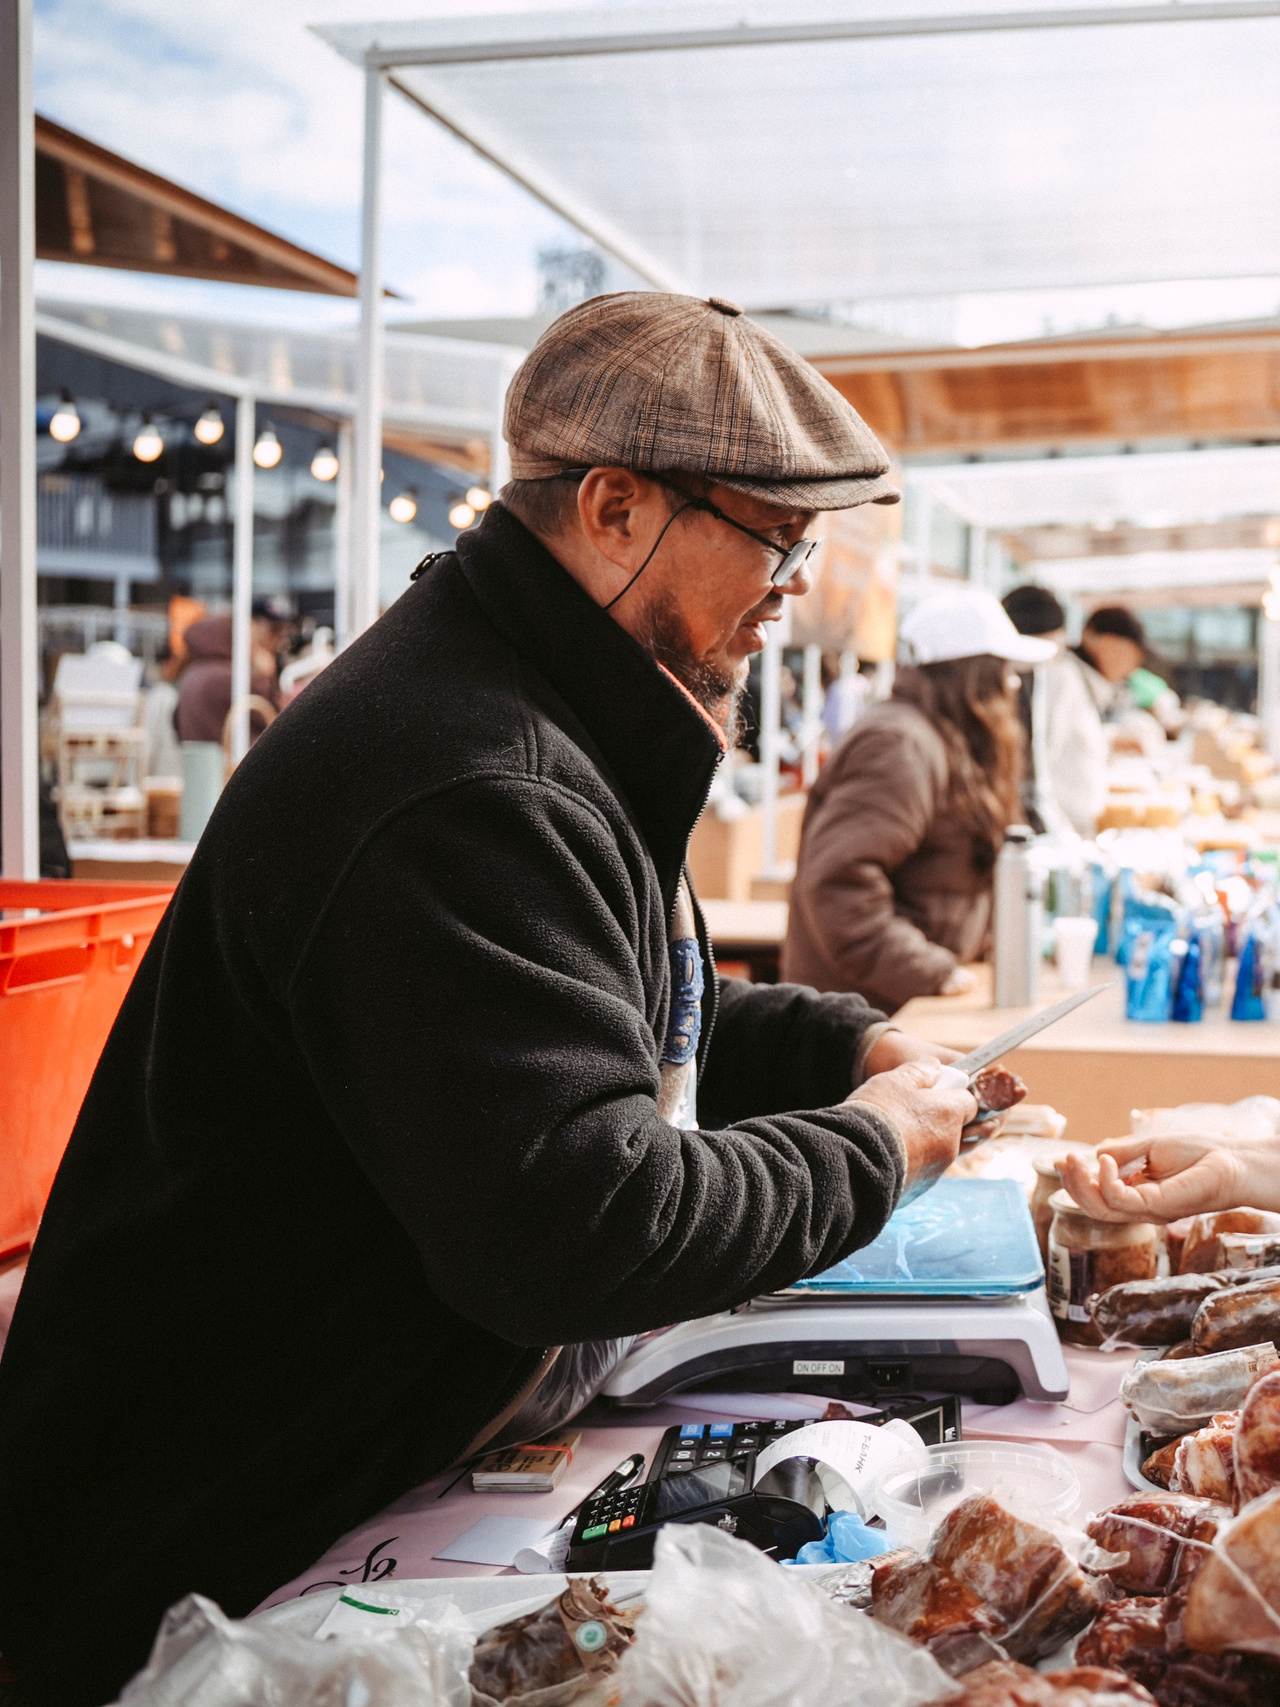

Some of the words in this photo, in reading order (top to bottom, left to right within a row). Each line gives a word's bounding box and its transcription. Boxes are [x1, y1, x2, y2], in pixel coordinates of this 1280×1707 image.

[796, 1363, 809, 1372] ON
[810, 1363, 828, 1372] OFF
[829, 1364, 842, 1373] ON
